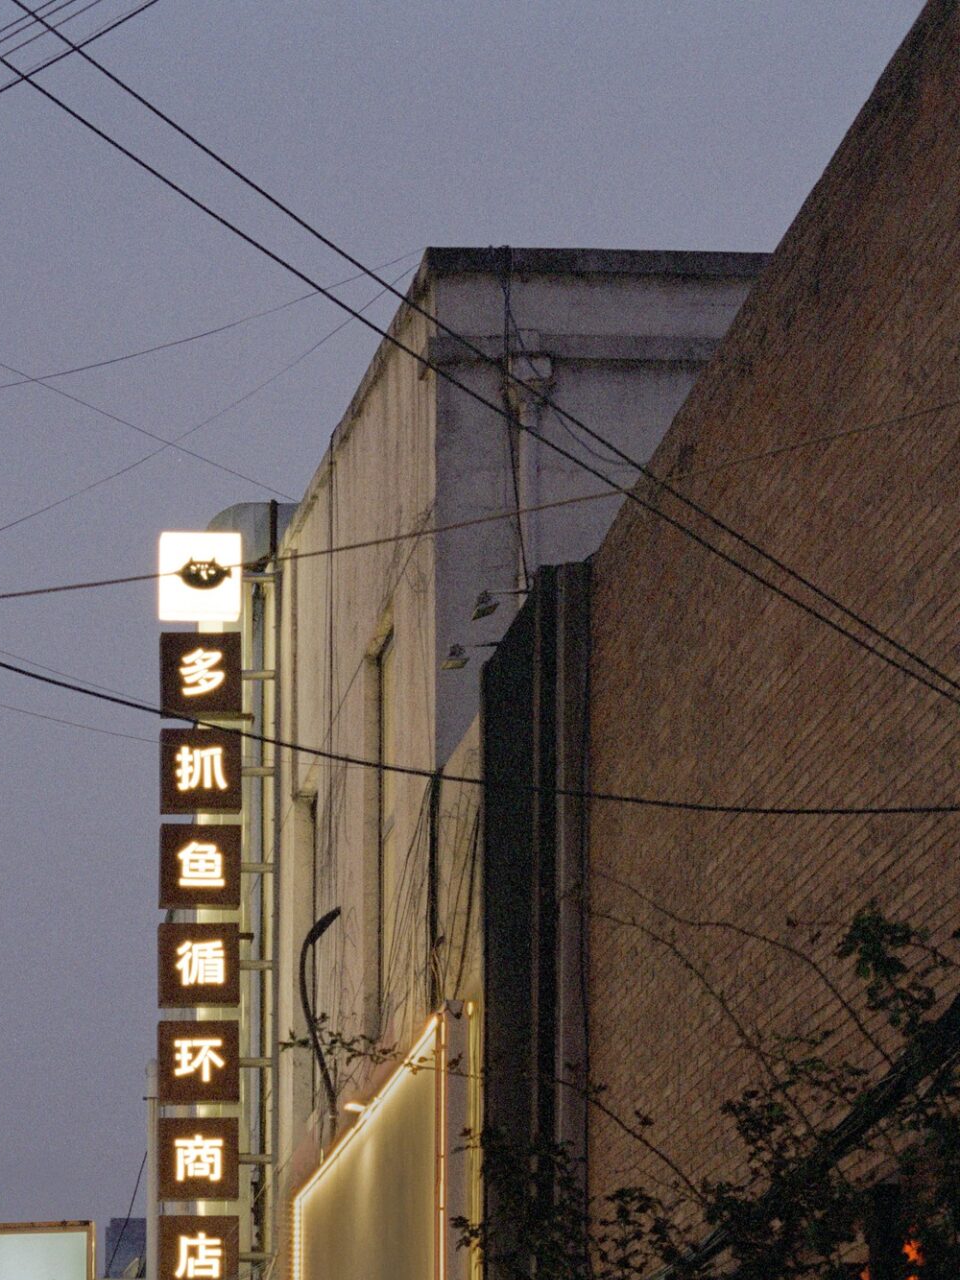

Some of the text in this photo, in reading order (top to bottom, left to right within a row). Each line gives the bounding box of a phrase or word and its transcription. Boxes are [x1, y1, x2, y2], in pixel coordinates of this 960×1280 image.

[173, 648, 226, 1280] 多抓鱼循环商店
